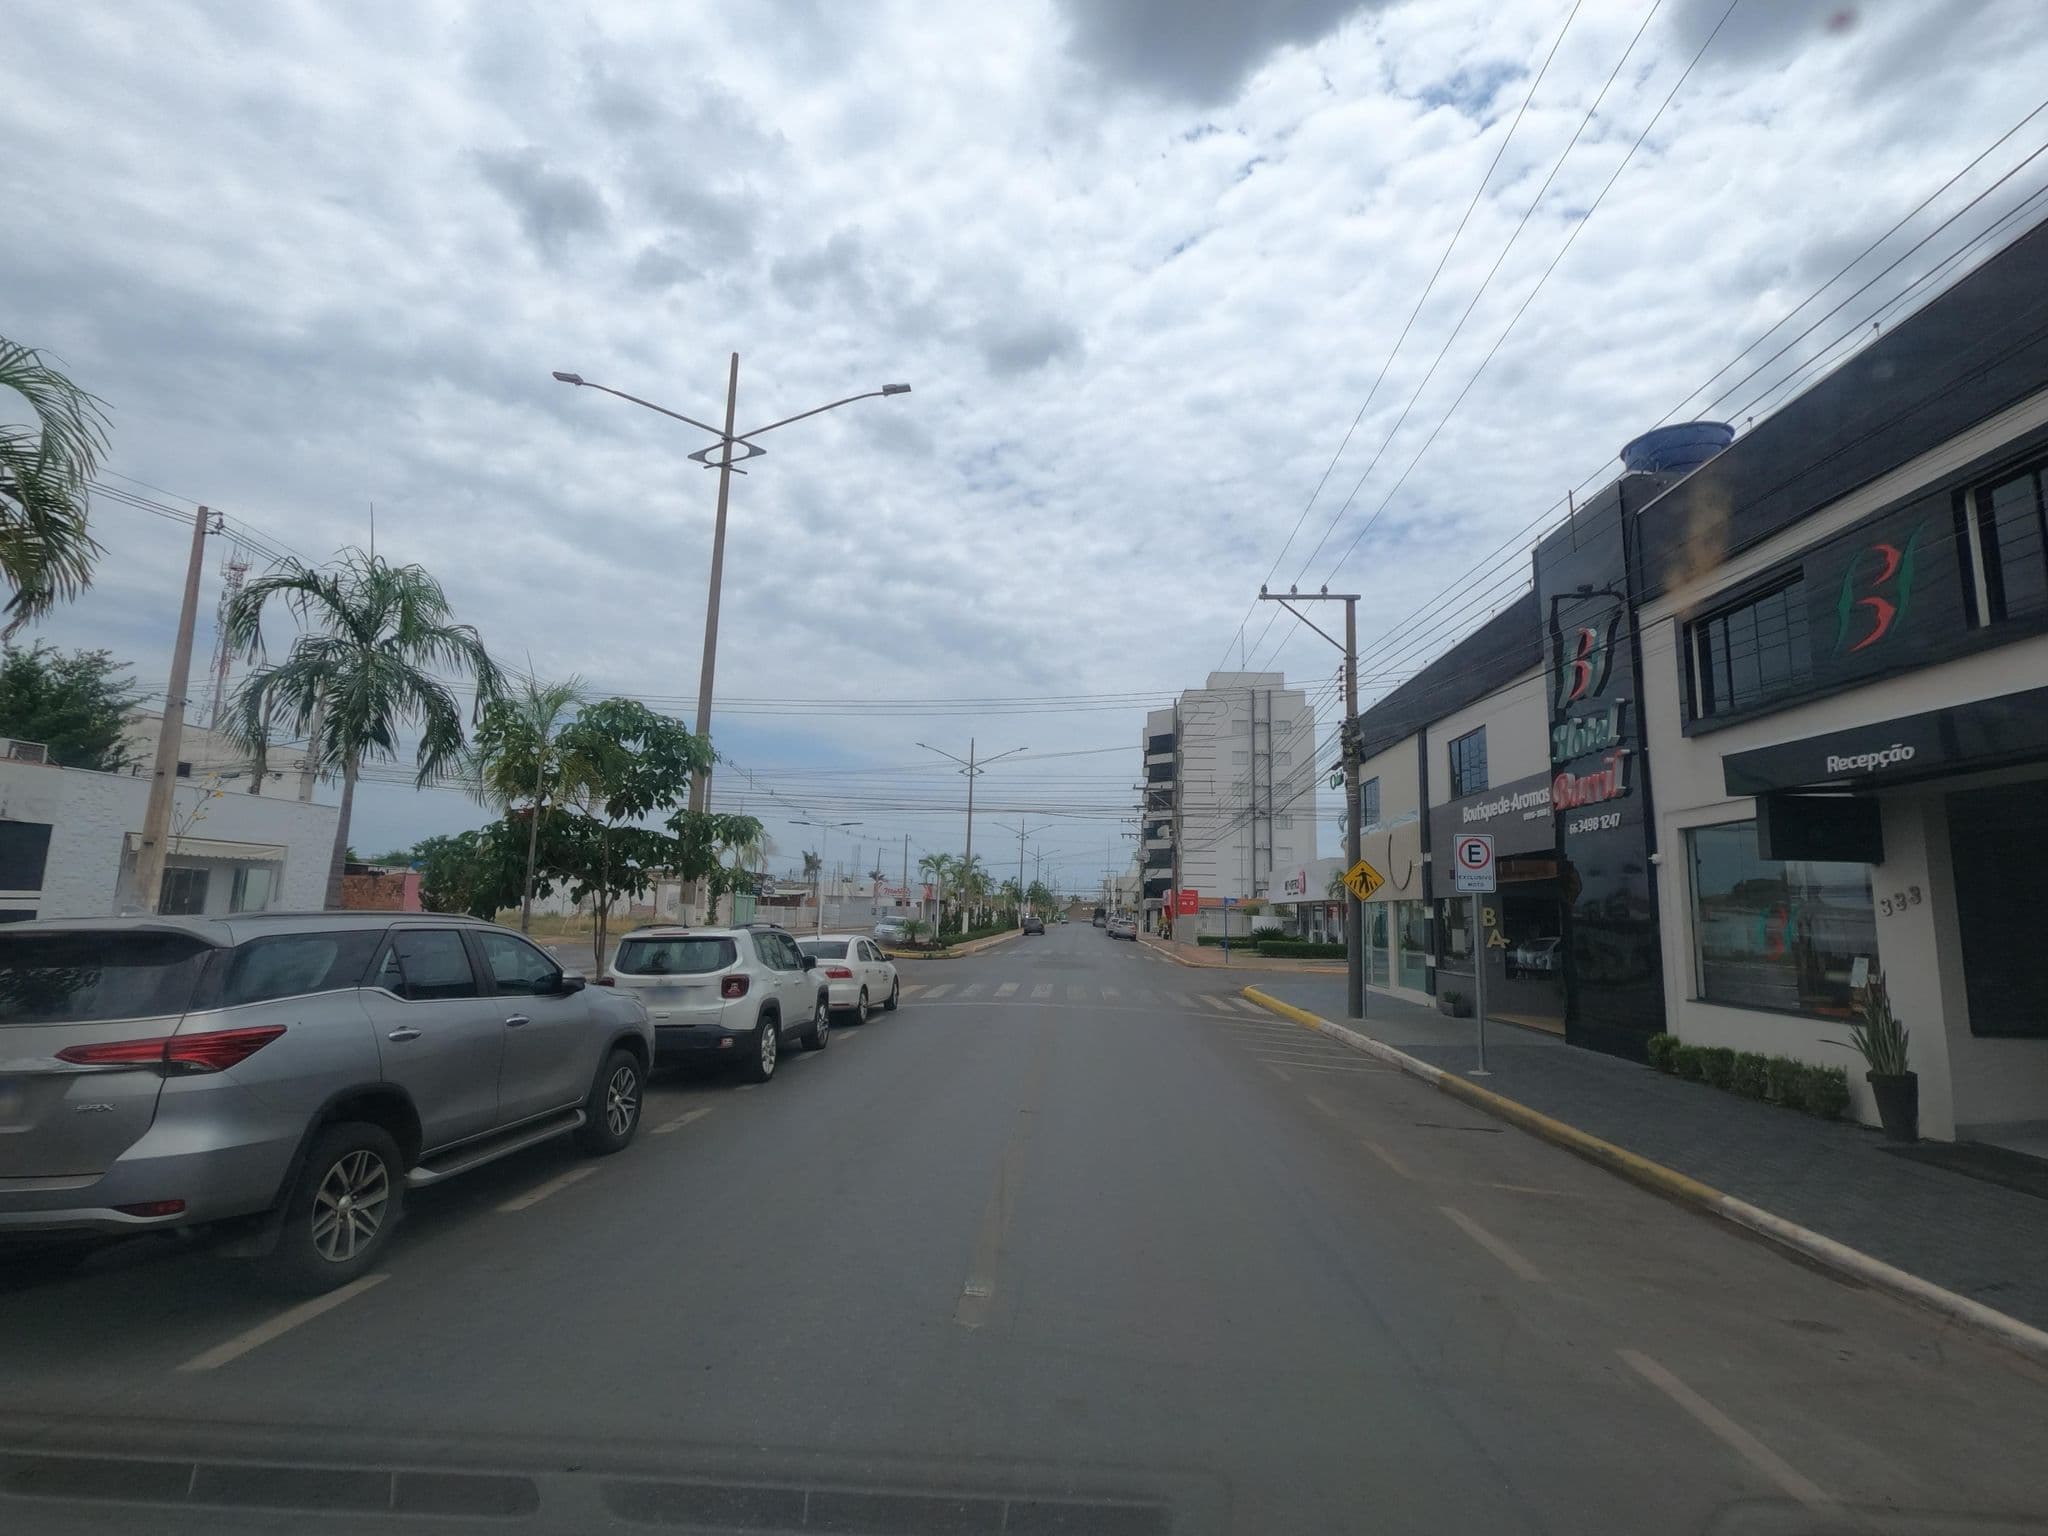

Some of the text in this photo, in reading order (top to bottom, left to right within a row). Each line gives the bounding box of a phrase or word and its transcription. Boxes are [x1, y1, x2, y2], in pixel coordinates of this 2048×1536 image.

[1552, 698, 1624, 763] Hotel
[1826, 743, 1915, 773] Recepção
[1462, 801, 1498, 824] Boutique
[1498, 796, 1510, 814] de
[1511, 787, 1551, 812] Aromas
[1578, 816, 1599, 832] 3498
[1468, 844, 1482, 863] E
